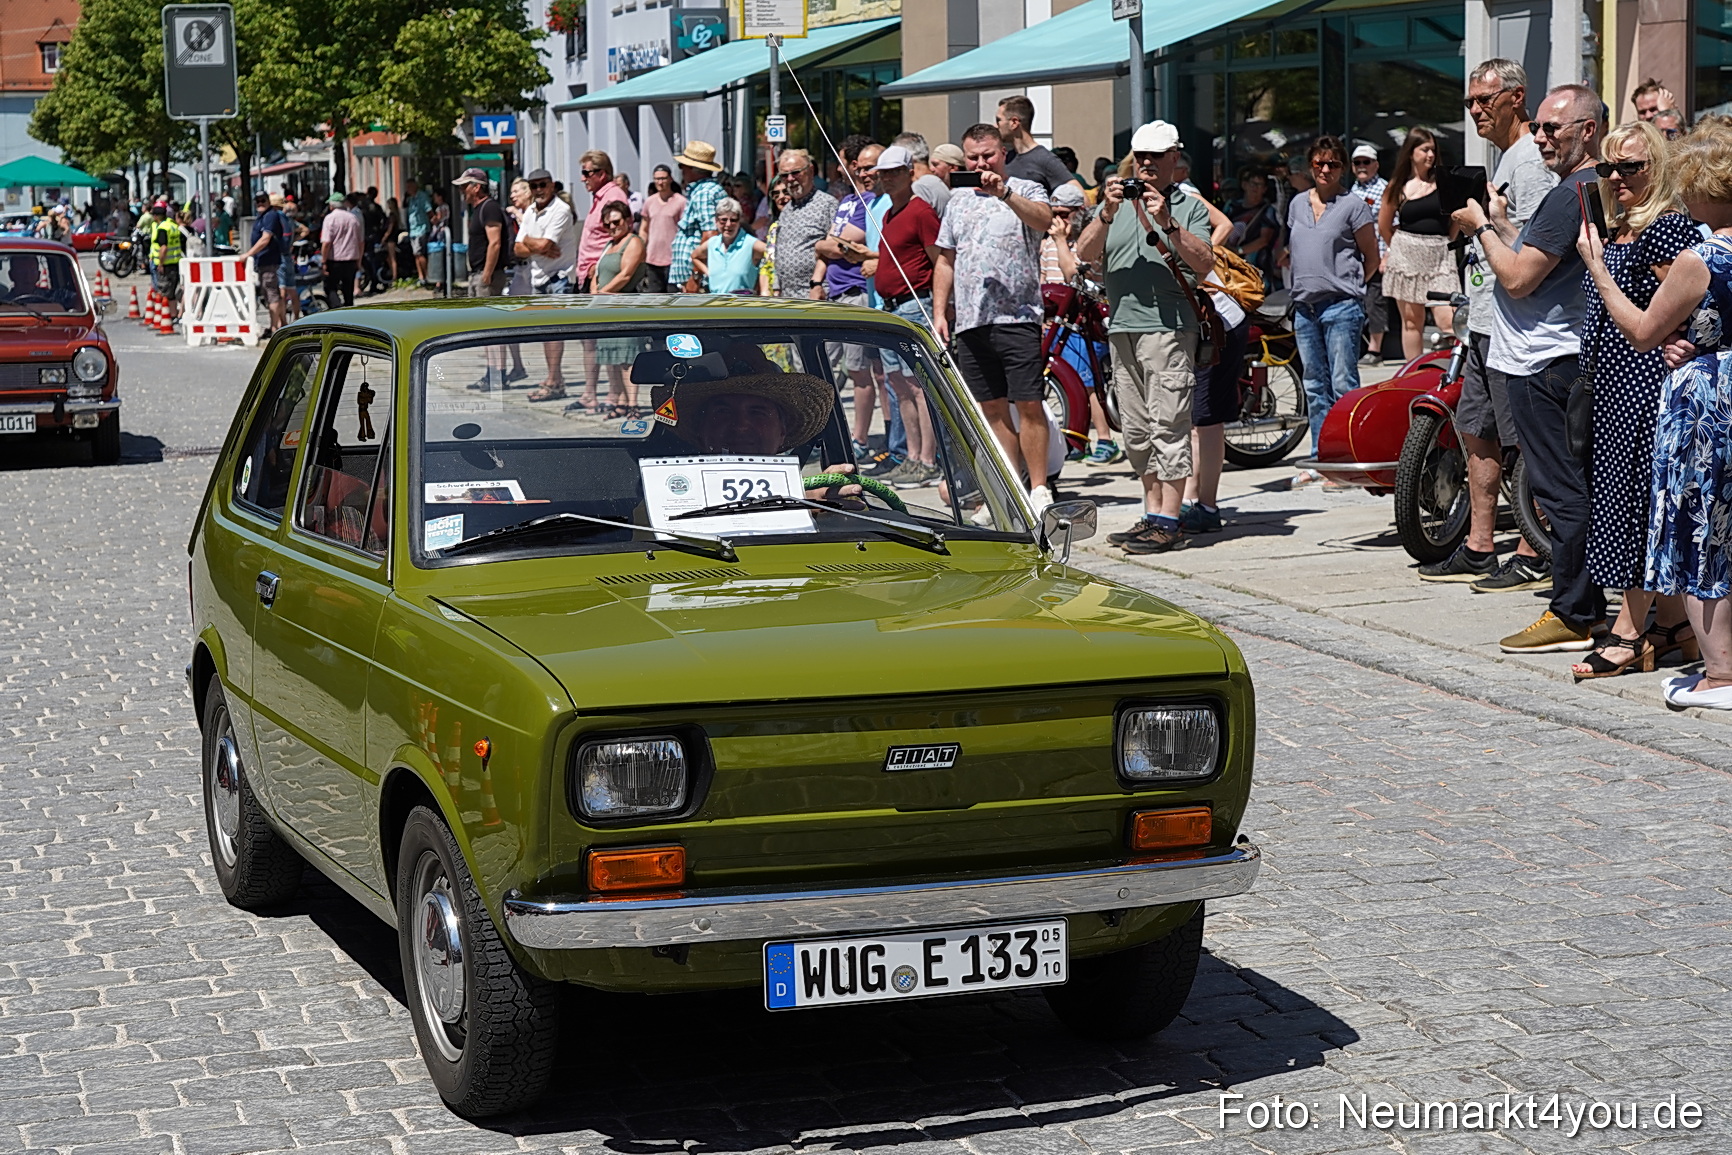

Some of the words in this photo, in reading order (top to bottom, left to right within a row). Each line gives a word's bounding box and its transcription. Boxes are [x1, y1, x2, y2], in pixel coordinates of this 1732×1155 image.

[691, 24, 713, 49] G2
[722, 478, 773, 502] 523
[427, 518, 461, 532] LICHT
[893, 748, 953, 763] FIAT
[776, 983, 787, 997] D
[801, 944, 887, 998] WUG
[922, 938, 949, 987] E
[960, 929, 1039, 984] 133
[1041, 928, 1061, 942] 05
[1043, 961, 1061, 976] 10
